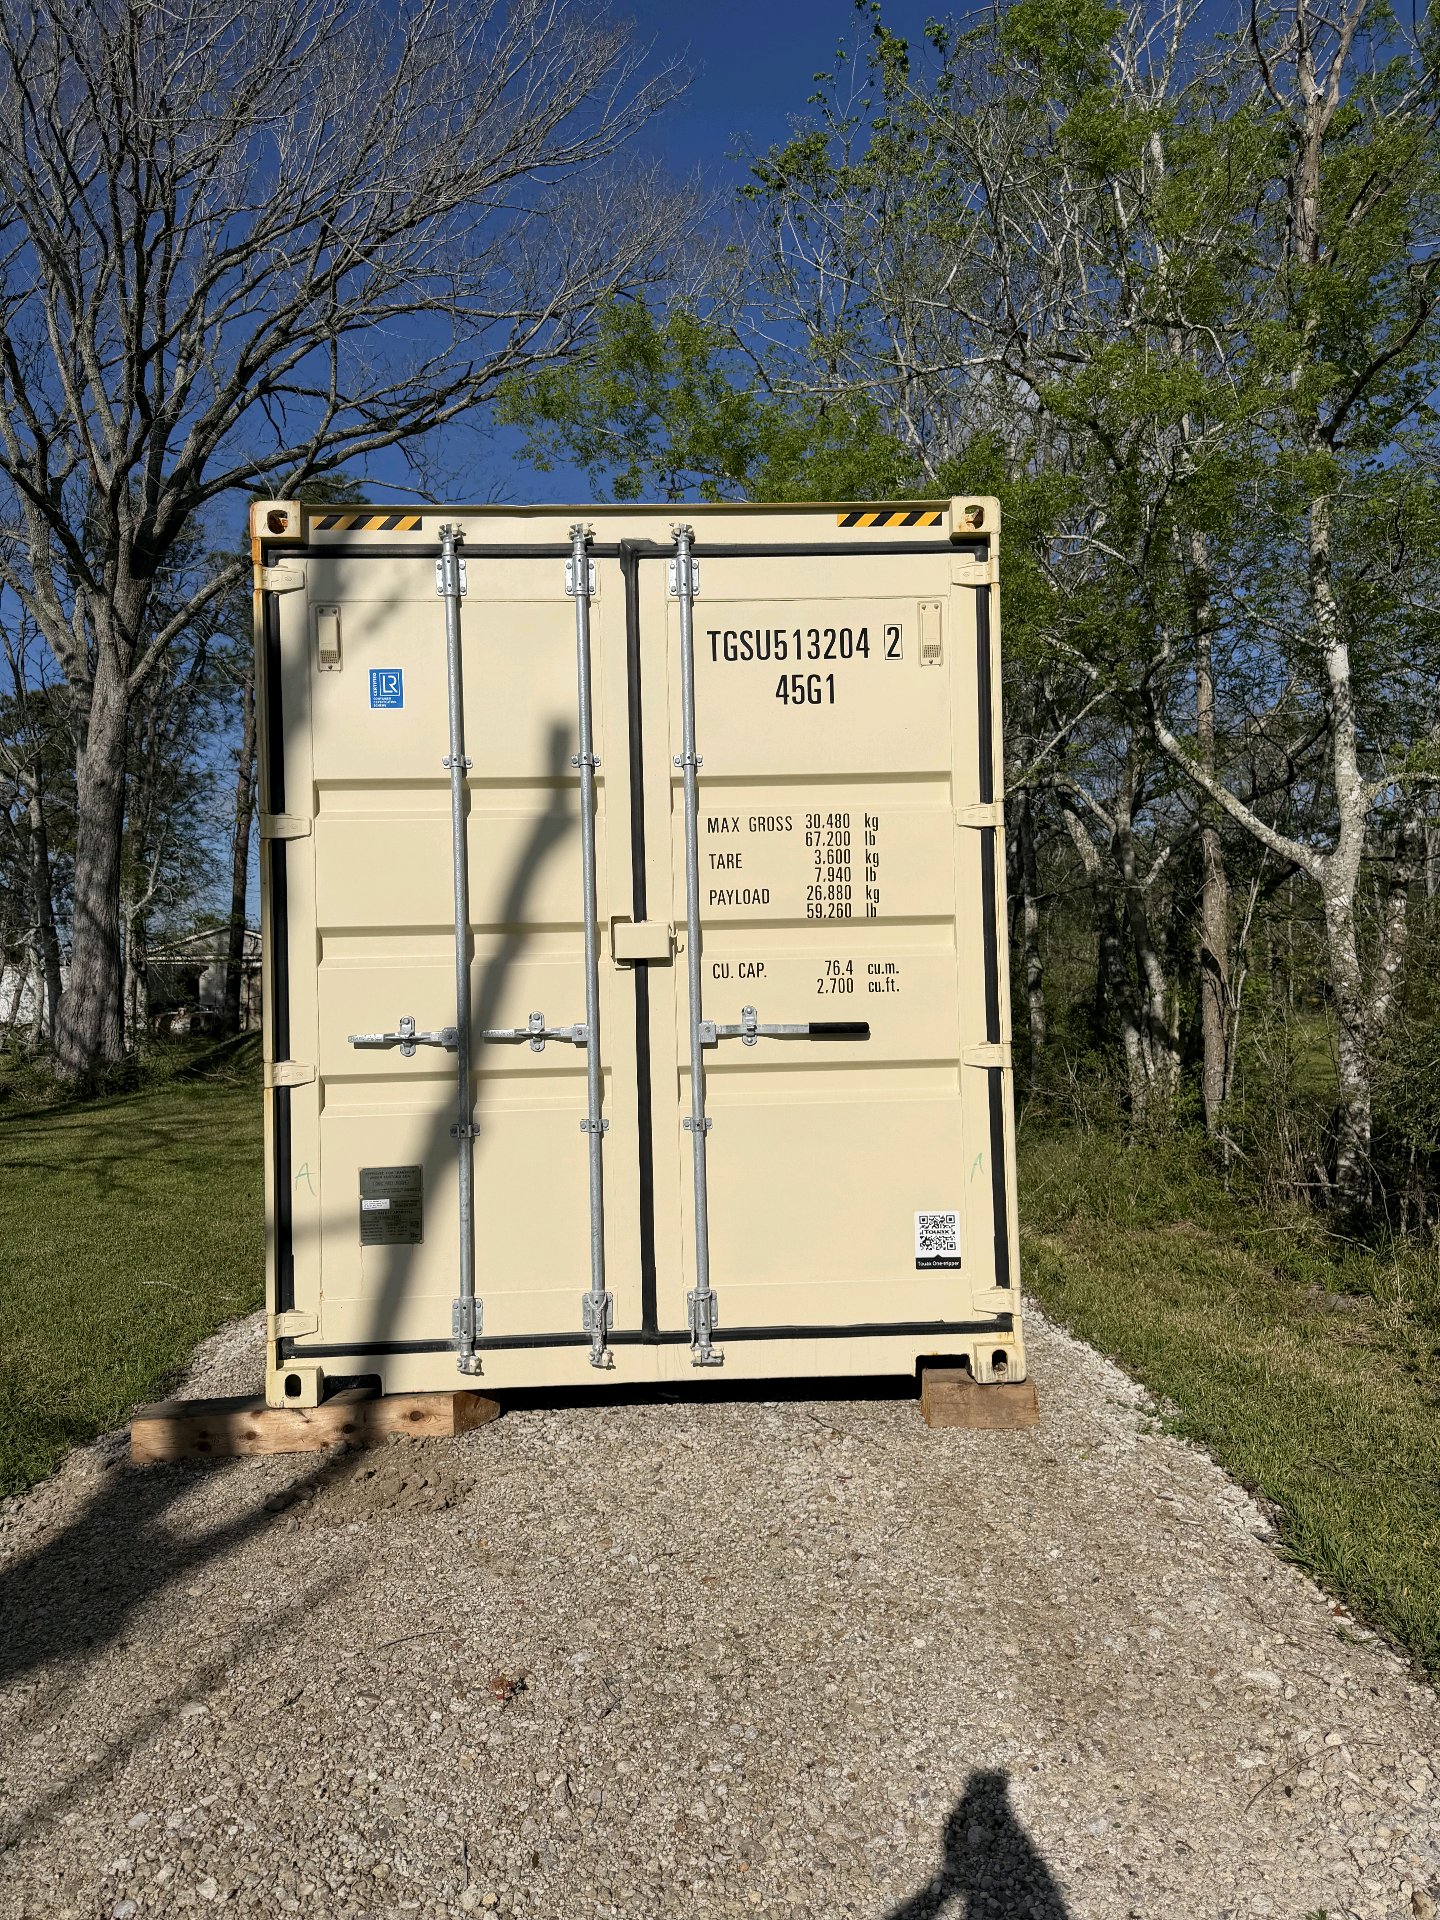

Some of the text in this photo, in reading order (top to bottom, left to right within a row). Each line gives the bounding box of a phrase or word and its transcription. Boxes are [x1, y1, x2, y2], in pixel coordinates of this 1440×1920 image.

[707, 626, 901, 661] TGSU513204 2
[776, 674, 835, 705] 45G1
[708, 817, 740, 833] MAX
[749, 815, 793, 832] GROSS
[864, 812, 879, 831] kg
[864, 831, 876, 846] lb
[709, 853, 743, 870] TARE
[865, 849, 880, 867] kg
[865, 866, 877, 882] lb
[709, 889, 770, 905] PAYLOAD
[865, 885, 880, 903] kg
[866, 903, 877, 918] lb
[712, 962, 768, 979] CU. CAP.
[824, 960, 900, 976] 76.4 cu.m.
[868, 977, 900, 993] cu.ft.
